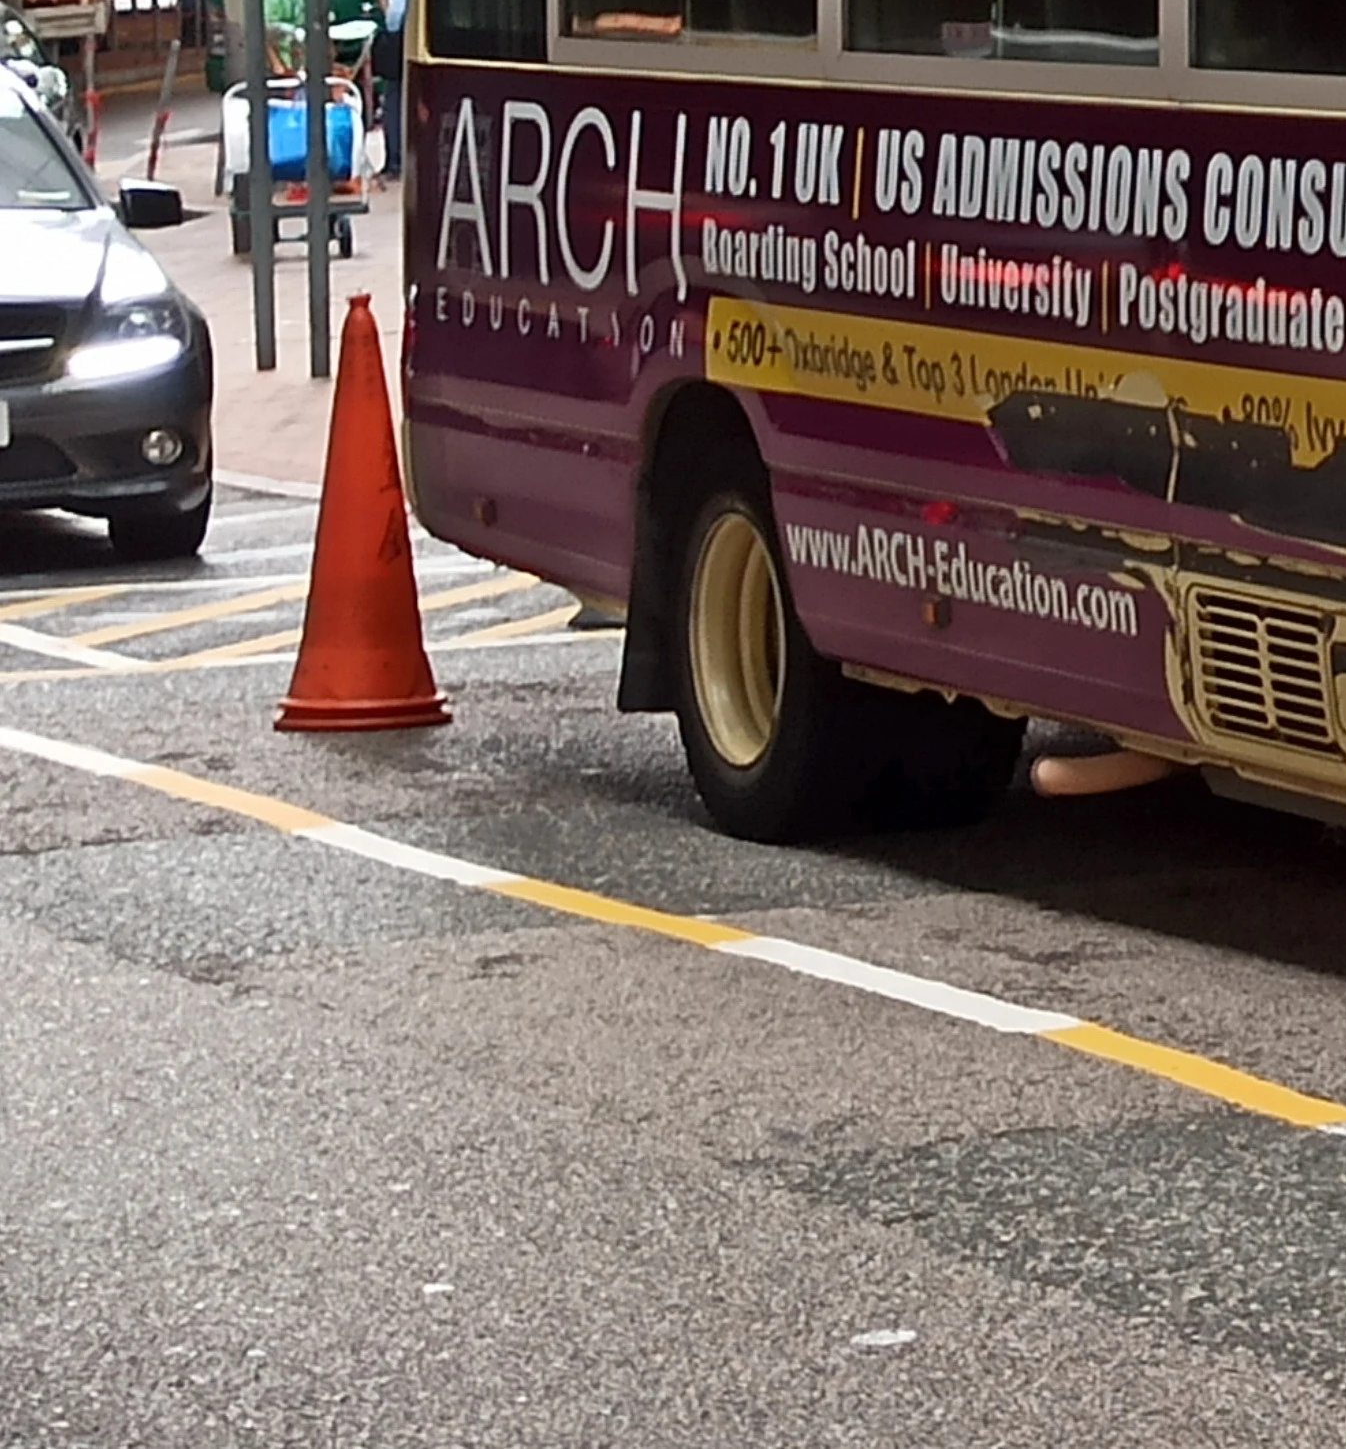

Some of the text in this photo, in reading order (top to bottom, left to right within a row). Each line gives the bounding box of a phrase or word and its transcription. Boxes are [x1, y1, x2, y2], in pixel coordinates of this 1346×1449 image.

[437, 96, 689, 304] ARCH
[705, 116, 757, 197] NO.
[770, 121, 786, 200] 1
[794, 123, 844, 206] UK
[875, 129, 924, 214] US
[932, 133, 1191, 242] ADMISSIONS
[436, 286, 686, 358] EDUCATION
[703, 217, 1346, 353] Boarding School University Postgraduate
[726, 319, 783, 367] 500+
[881, 340, 899, 385] &
[903, 344, 945, 404] Top
[951, 352, 966, 398] 3
[785, 522, 1139, 637] www.ARCH-Education.com
